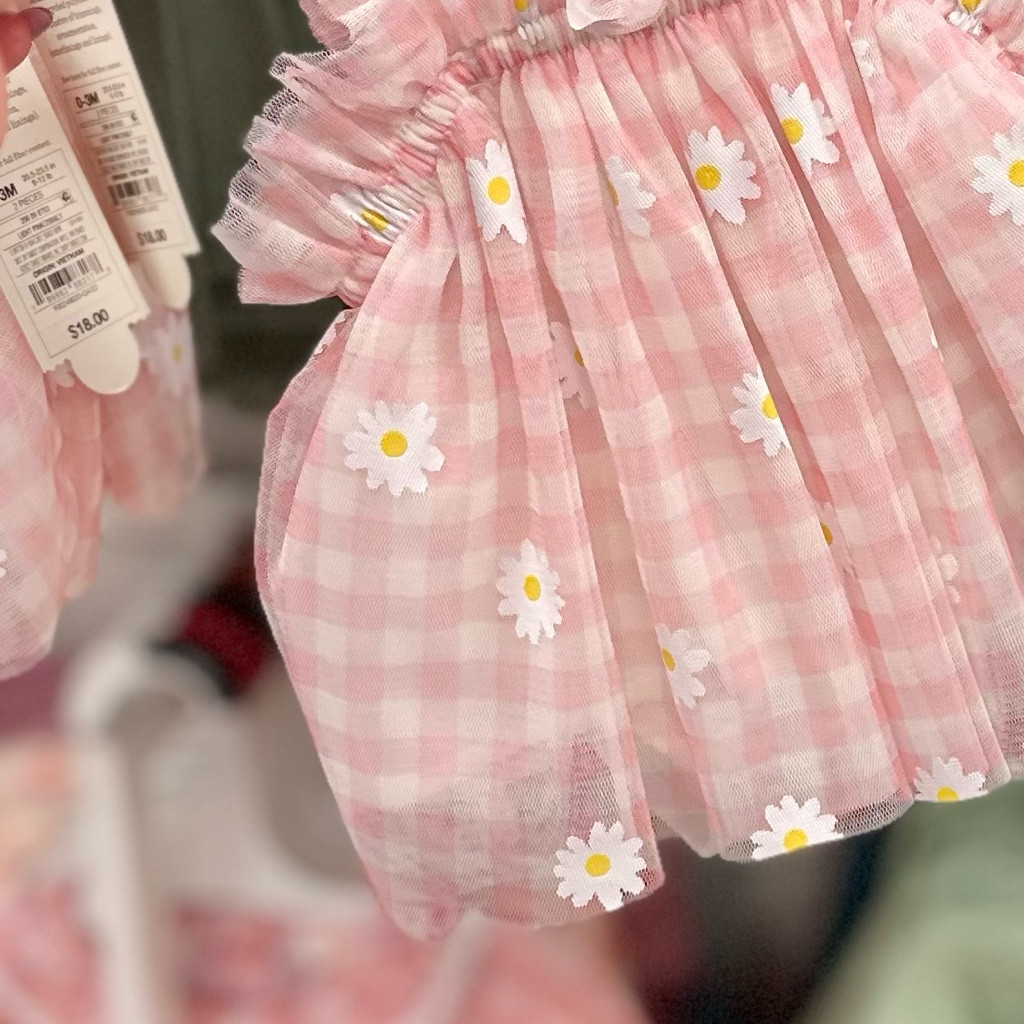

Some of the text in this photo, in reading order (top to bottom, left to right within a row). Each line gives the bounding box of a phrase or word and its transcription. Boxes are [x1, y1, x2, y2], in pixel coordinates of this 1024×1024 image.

[75, 91, 101, 109] 0-3M
[12, 189, 45, 211] 2 PIECES
[136, 228, 168, 247] $18.00
[55, 247, 85, 266] VIETNAM
[67, 308, 110, 339] $18.00
